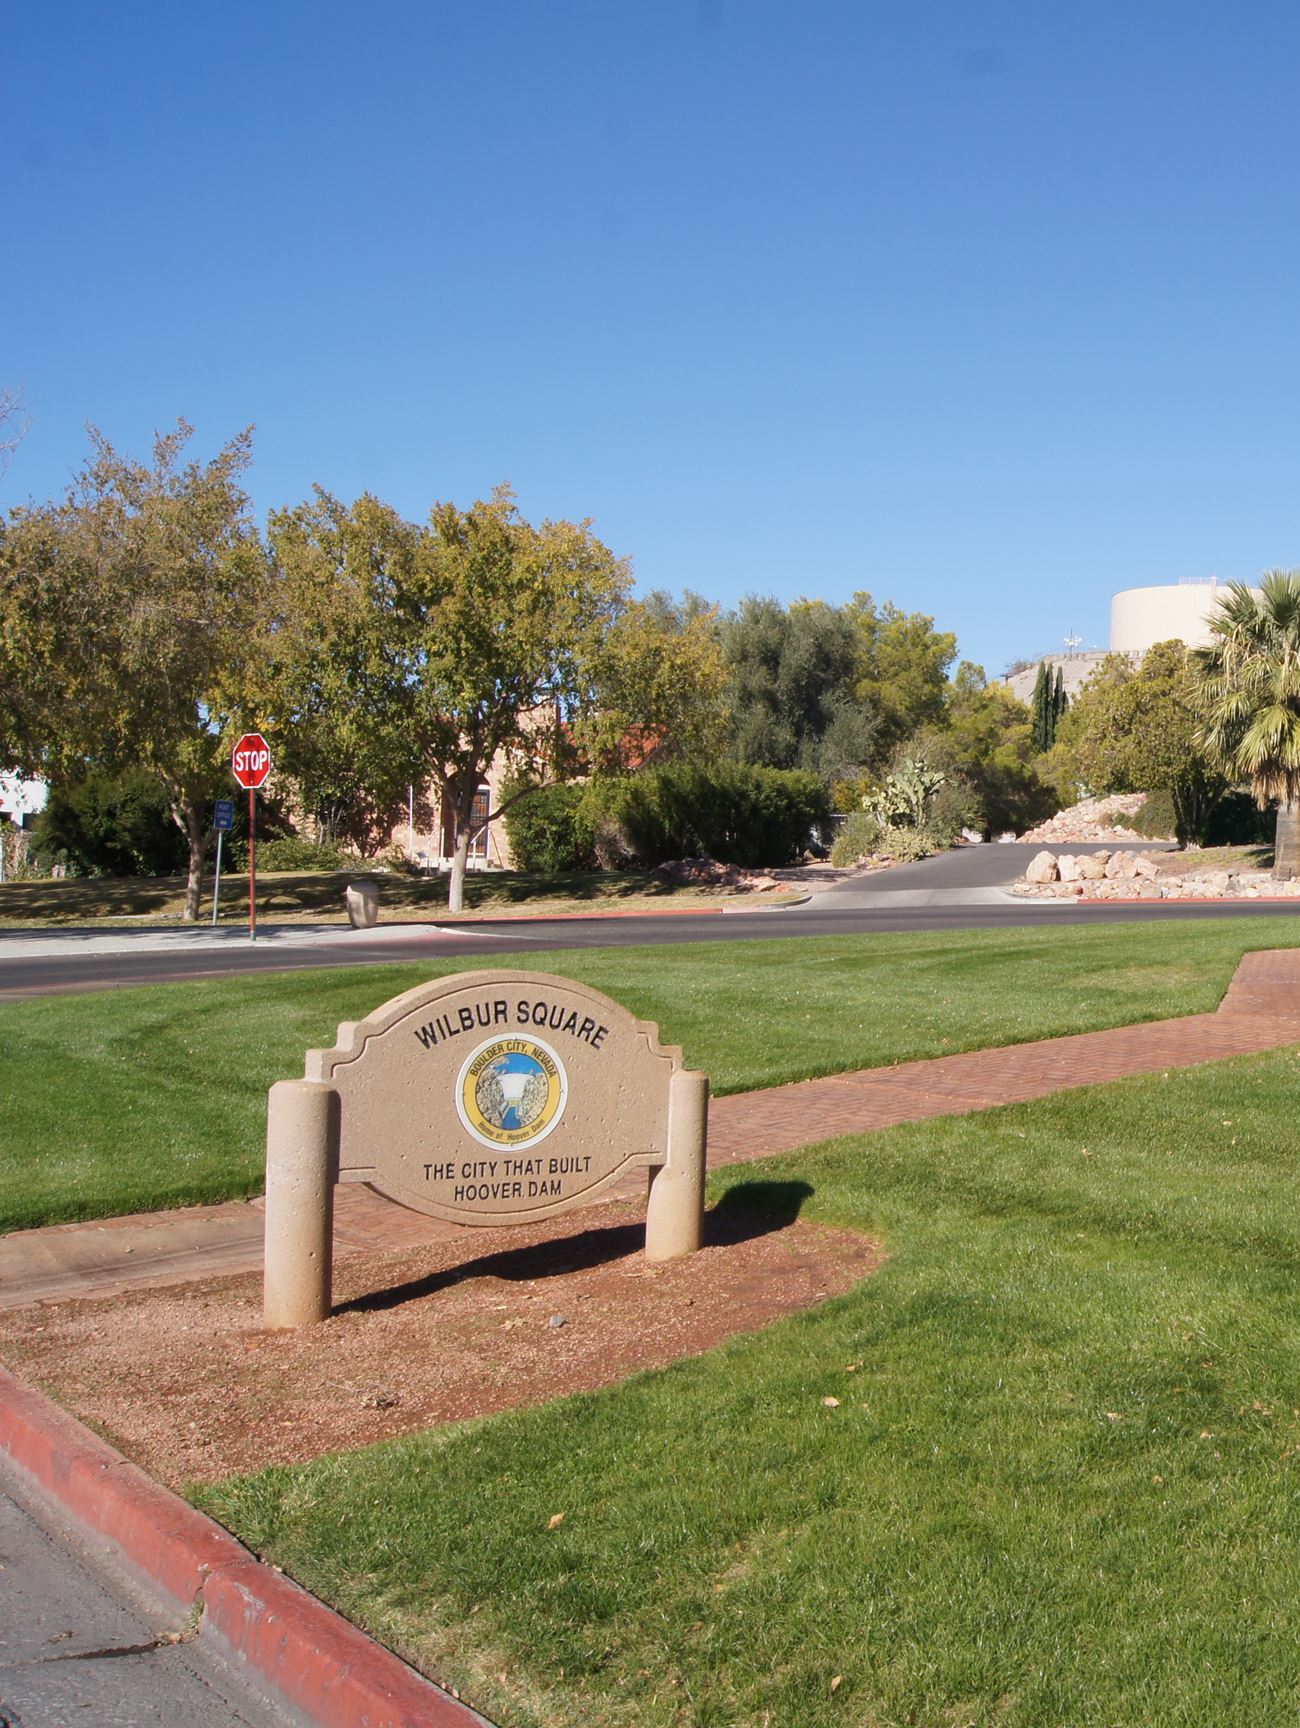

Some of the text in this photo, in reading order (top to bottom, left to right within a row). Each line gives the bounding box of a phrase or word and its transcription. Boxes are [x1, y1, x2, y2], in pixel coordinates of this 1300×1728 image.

[235, 751, 267, 771] STOP
[414, 1001, 609, 1049] WILBUR SQUARE
[470, 1044, 504, 1077] BOULDER
[531, 1047, 557, 1078] NEVADA
[478, 1121, 495, 1137] Home
[507, 1132, 530, 1141] Hoover
[531, 1119, 545, 1132] Dam
[424, 1156, 592, 1180] THE CITY THAT BUILT
[454, 1180, 562, 1201] HOOVER DAM
